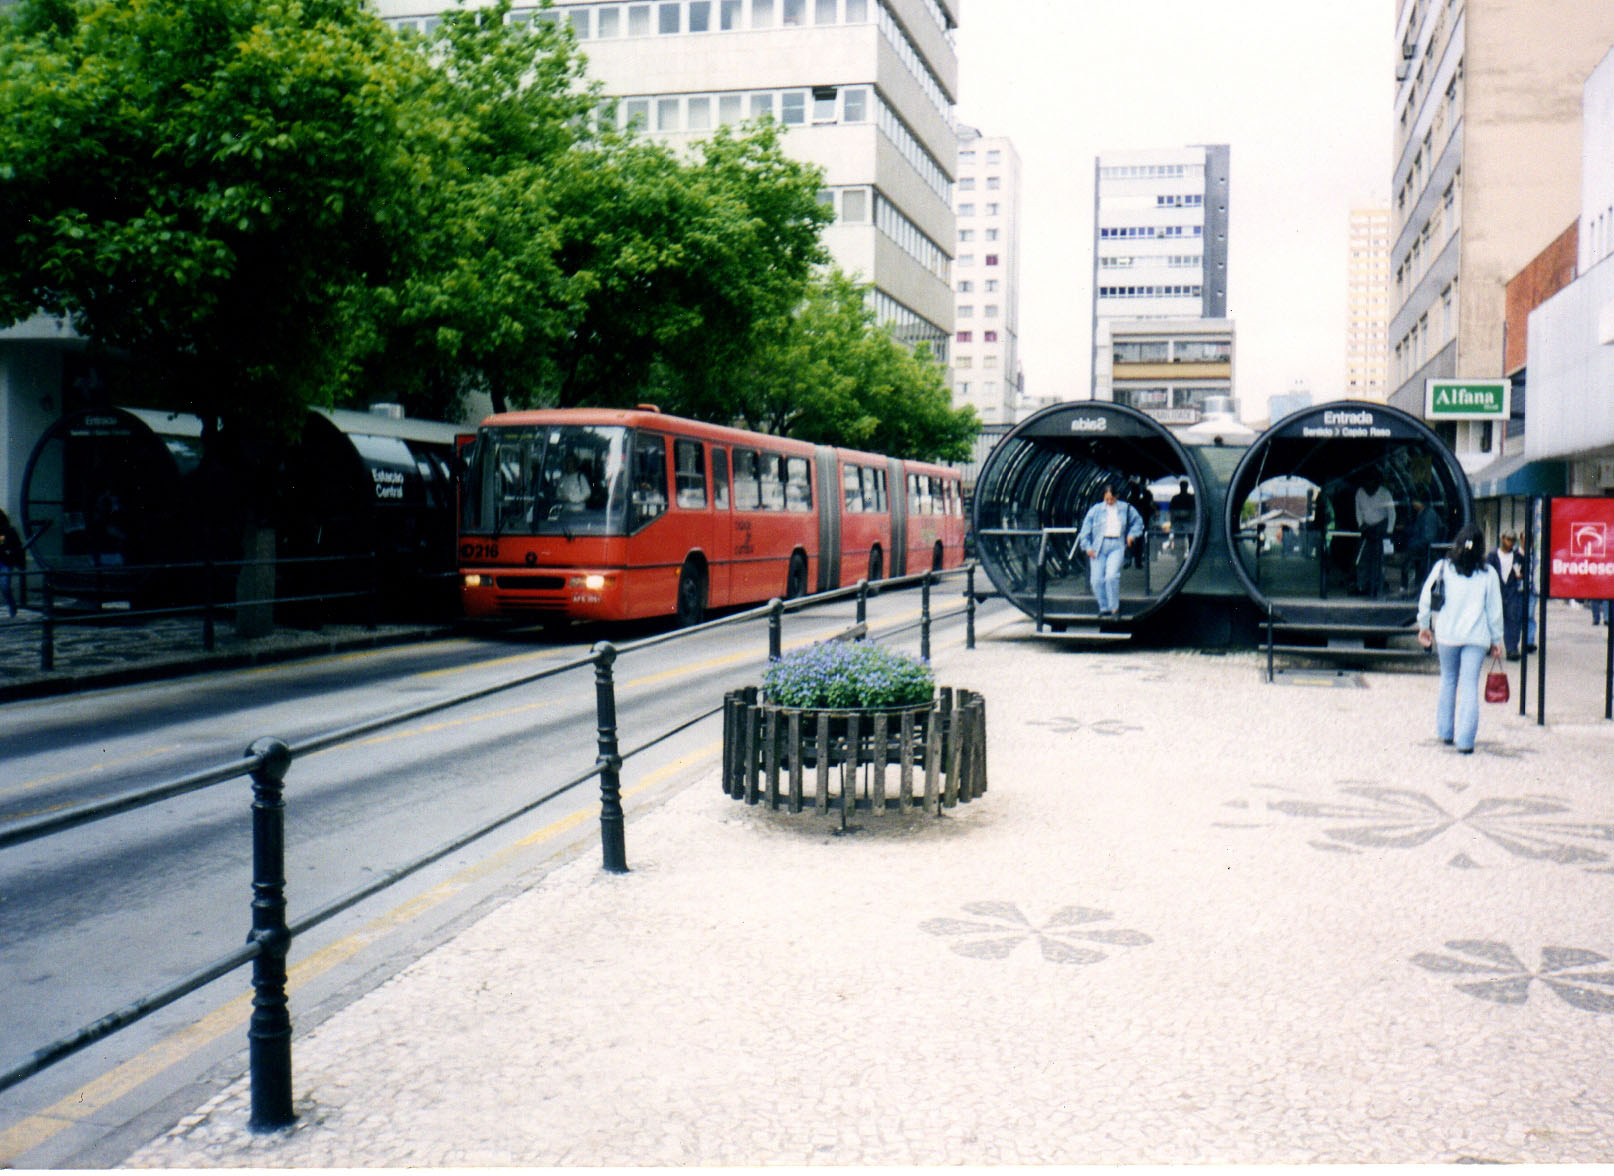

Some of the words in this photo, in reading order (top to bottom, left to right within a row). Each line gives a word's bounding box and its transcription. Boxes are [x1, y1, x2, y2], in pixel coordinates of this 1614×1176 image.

[1436, 388, 1495, 405] Alfana
[1323, 409, 1373, 424] Entrada
[376, 484, 403, 498] Central
